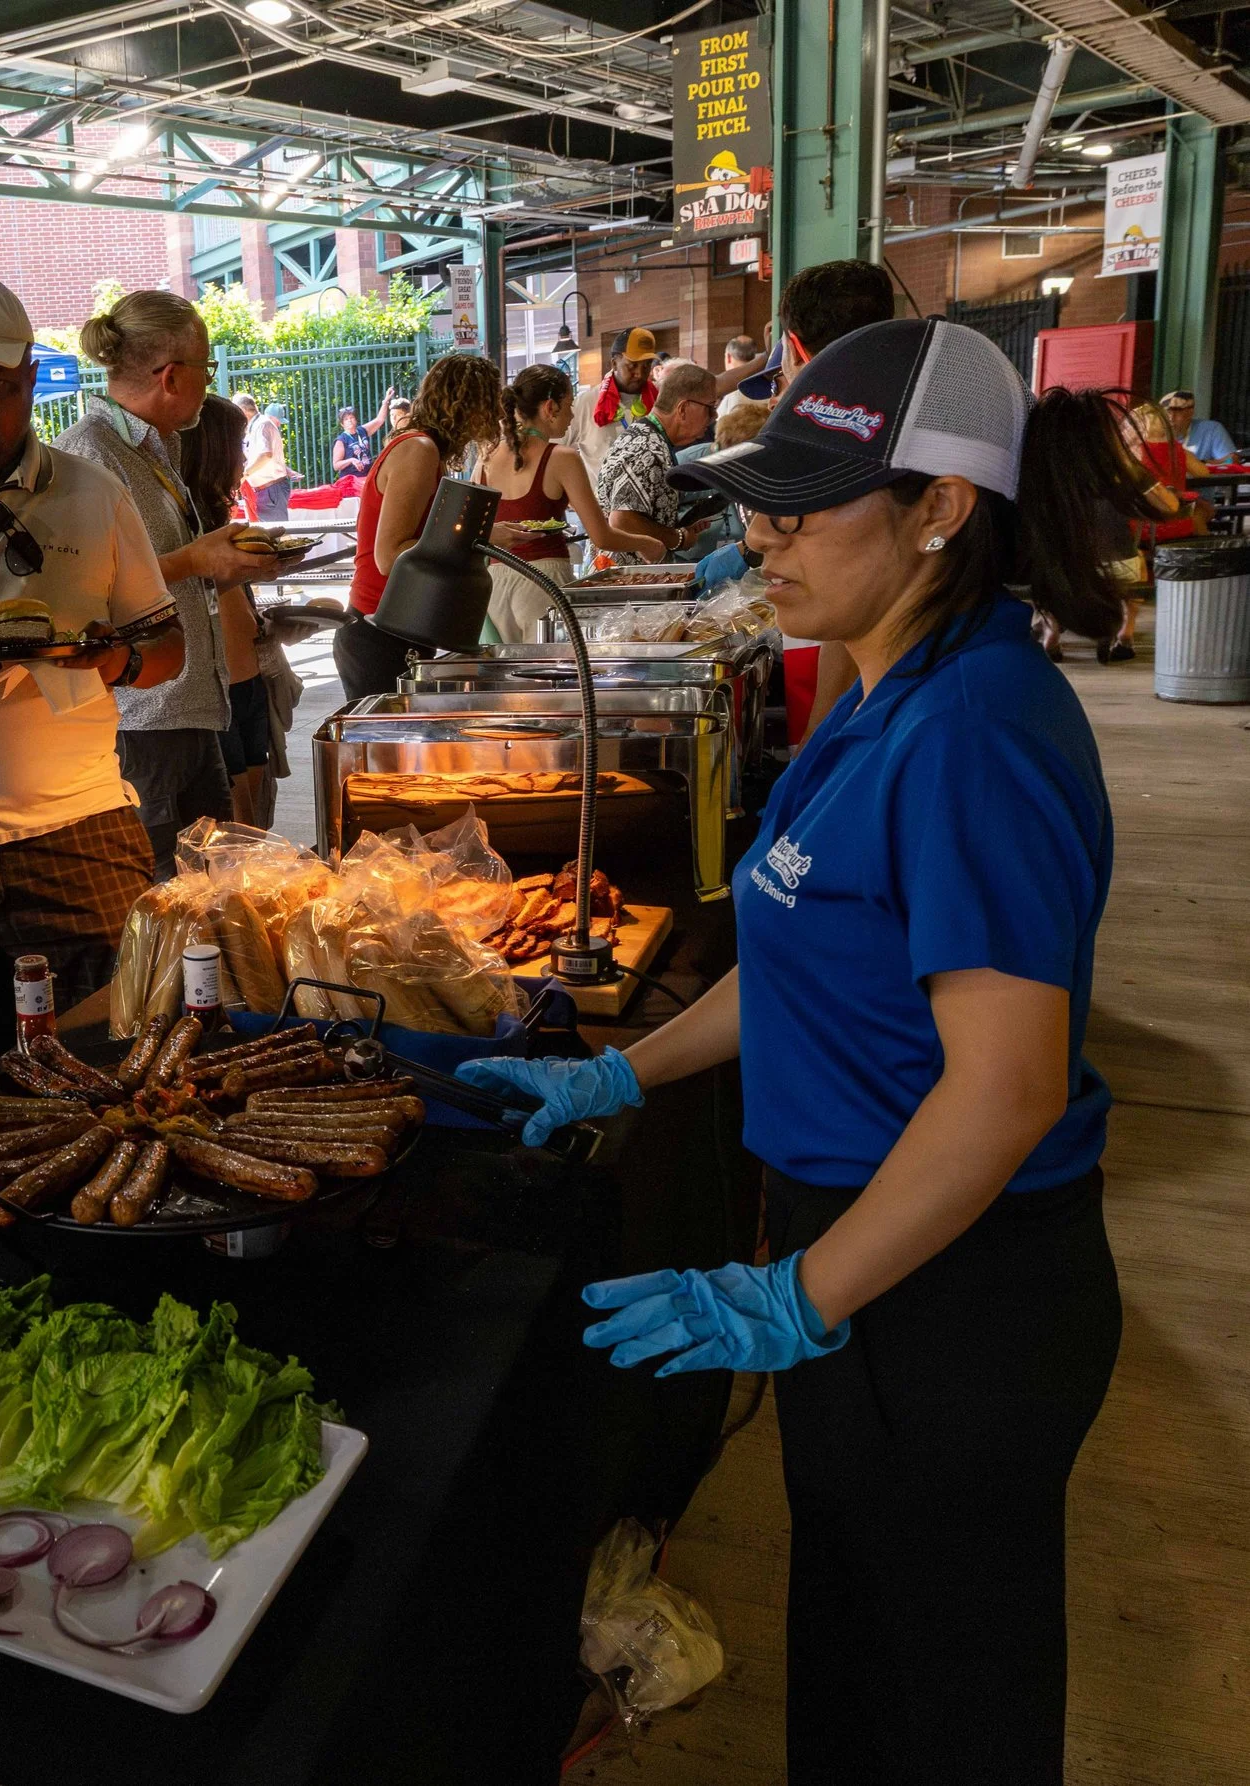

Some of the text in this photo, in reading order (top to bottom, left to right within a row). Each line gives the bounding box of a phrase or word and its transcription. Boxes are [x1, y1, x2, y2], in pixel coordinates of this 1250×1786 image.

[700, 31, 748, 56] FROM
[700, 52, 748, 77] FIRST
[688, 71, 761, 100] POUR TO
[697, 95, 748, 119] FINAL
[697, 116, 751, 140] PITCH.
[1118, 167, 1158, 182] CHEERS
[1112, 179, 1163, 196] Before the
[679, 192, 768, 223] SEA DOG
[1115, 192, 1158, 208] CHEERS!
[693, 209, 755, 232] BREWPEN
[734, 241, 754, 261] EXIT
[848, 407, 881, 427] Park
[57, 546, 79, 555] COLE
